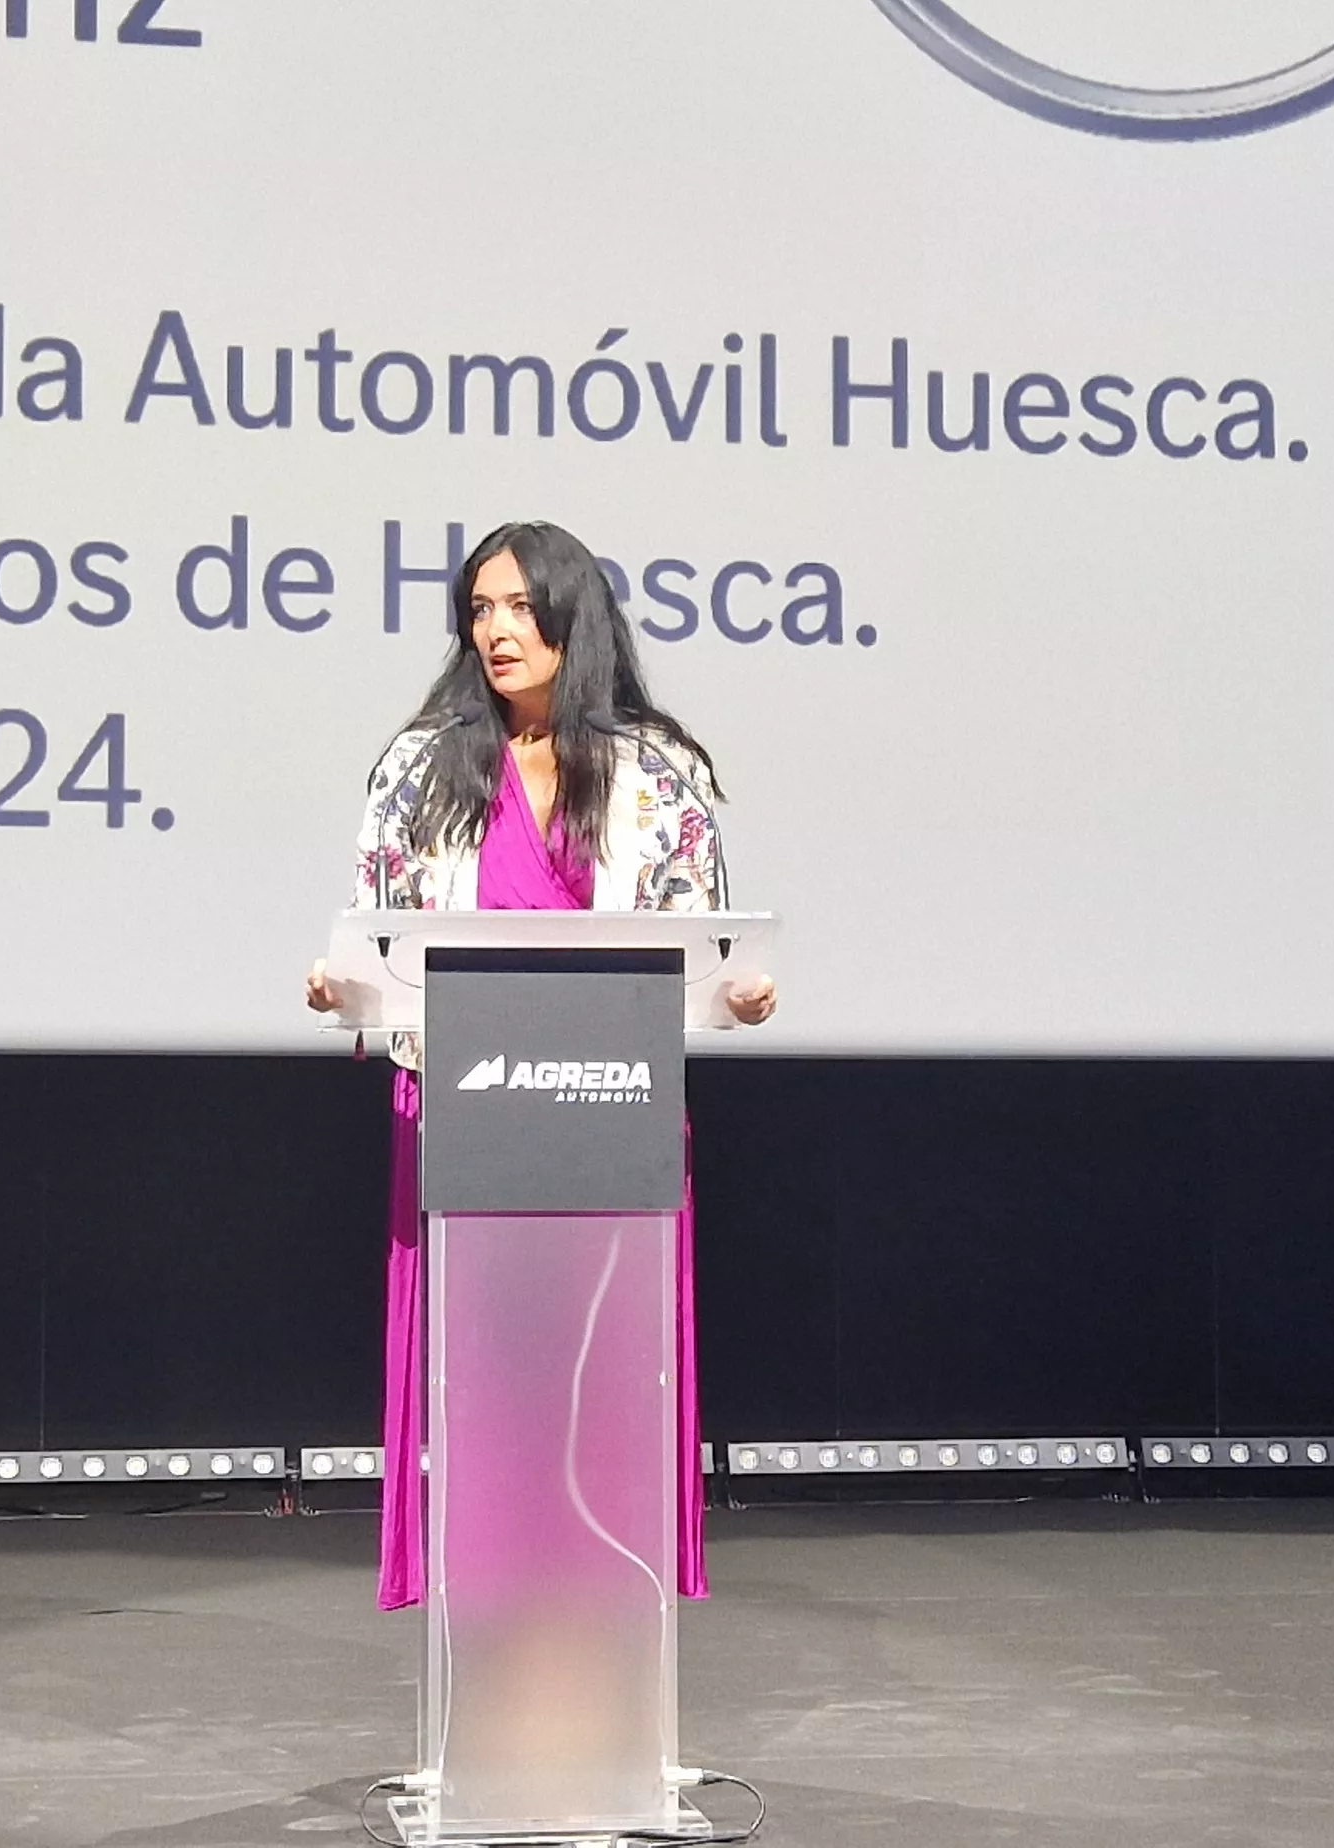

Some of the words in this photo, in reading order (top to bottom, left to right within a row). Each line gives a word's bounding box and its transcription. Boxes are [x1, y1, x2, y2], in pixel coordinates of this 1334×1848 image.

[124, 310, 788, 448] Automóvil
[832, 335, 1309, 463] Huesca.
[176, 514, 335, 633] de
[383, 519, 877, 648] Hsca.
[507, 1061, 652, 1090] AGREDA
